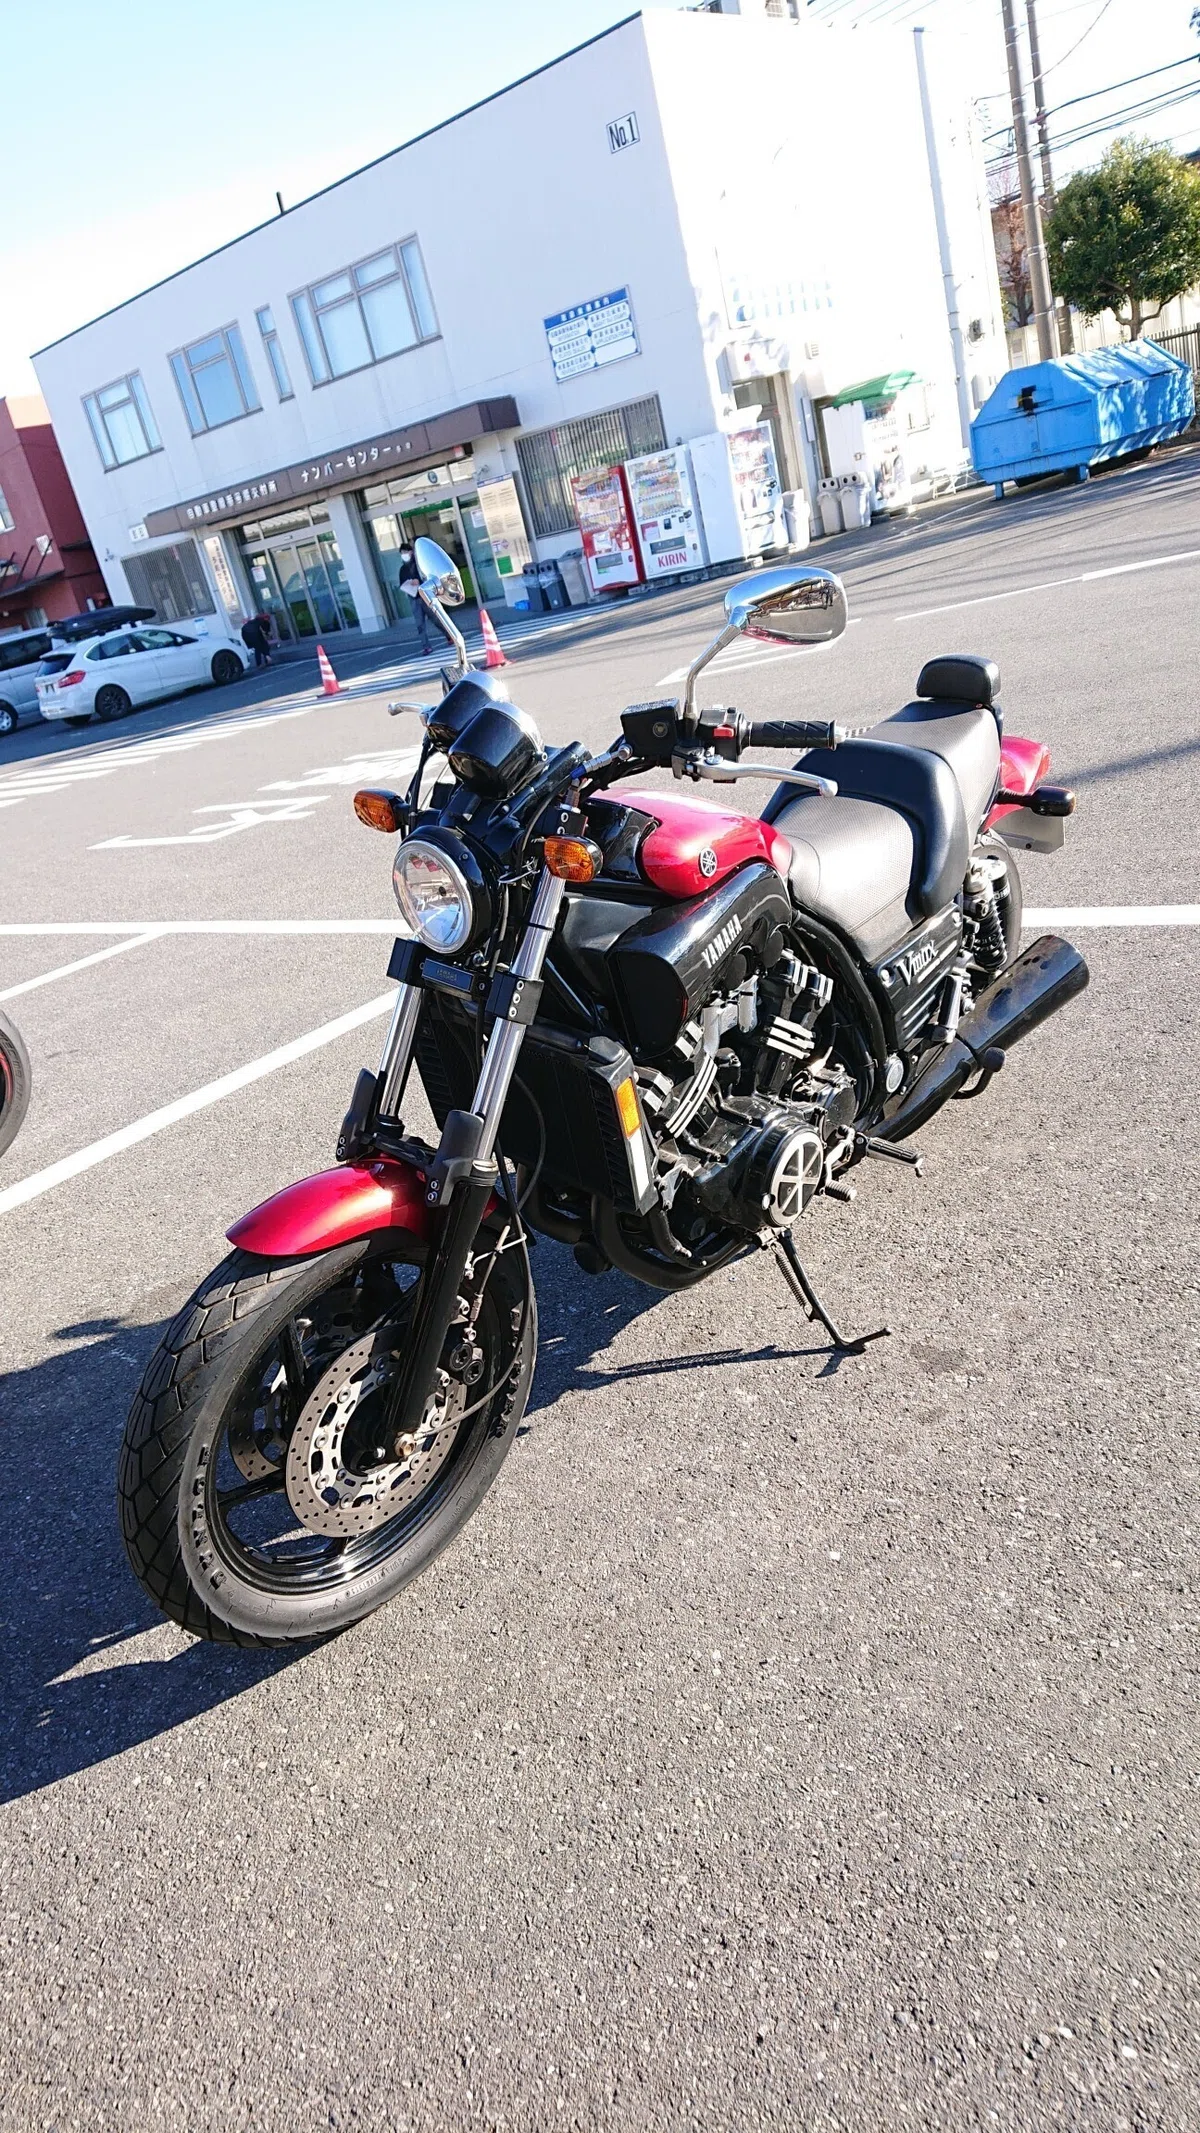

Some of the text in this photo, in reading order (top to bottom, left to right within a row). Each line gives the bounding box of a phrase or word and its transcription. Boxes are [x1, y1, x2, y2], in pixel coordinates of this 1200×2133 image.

[301, 447, 392, 483] ナンバーセンター
[658, 551, 688, 568] KIRIN
[701, 913, 743, 970] YAMAHA
